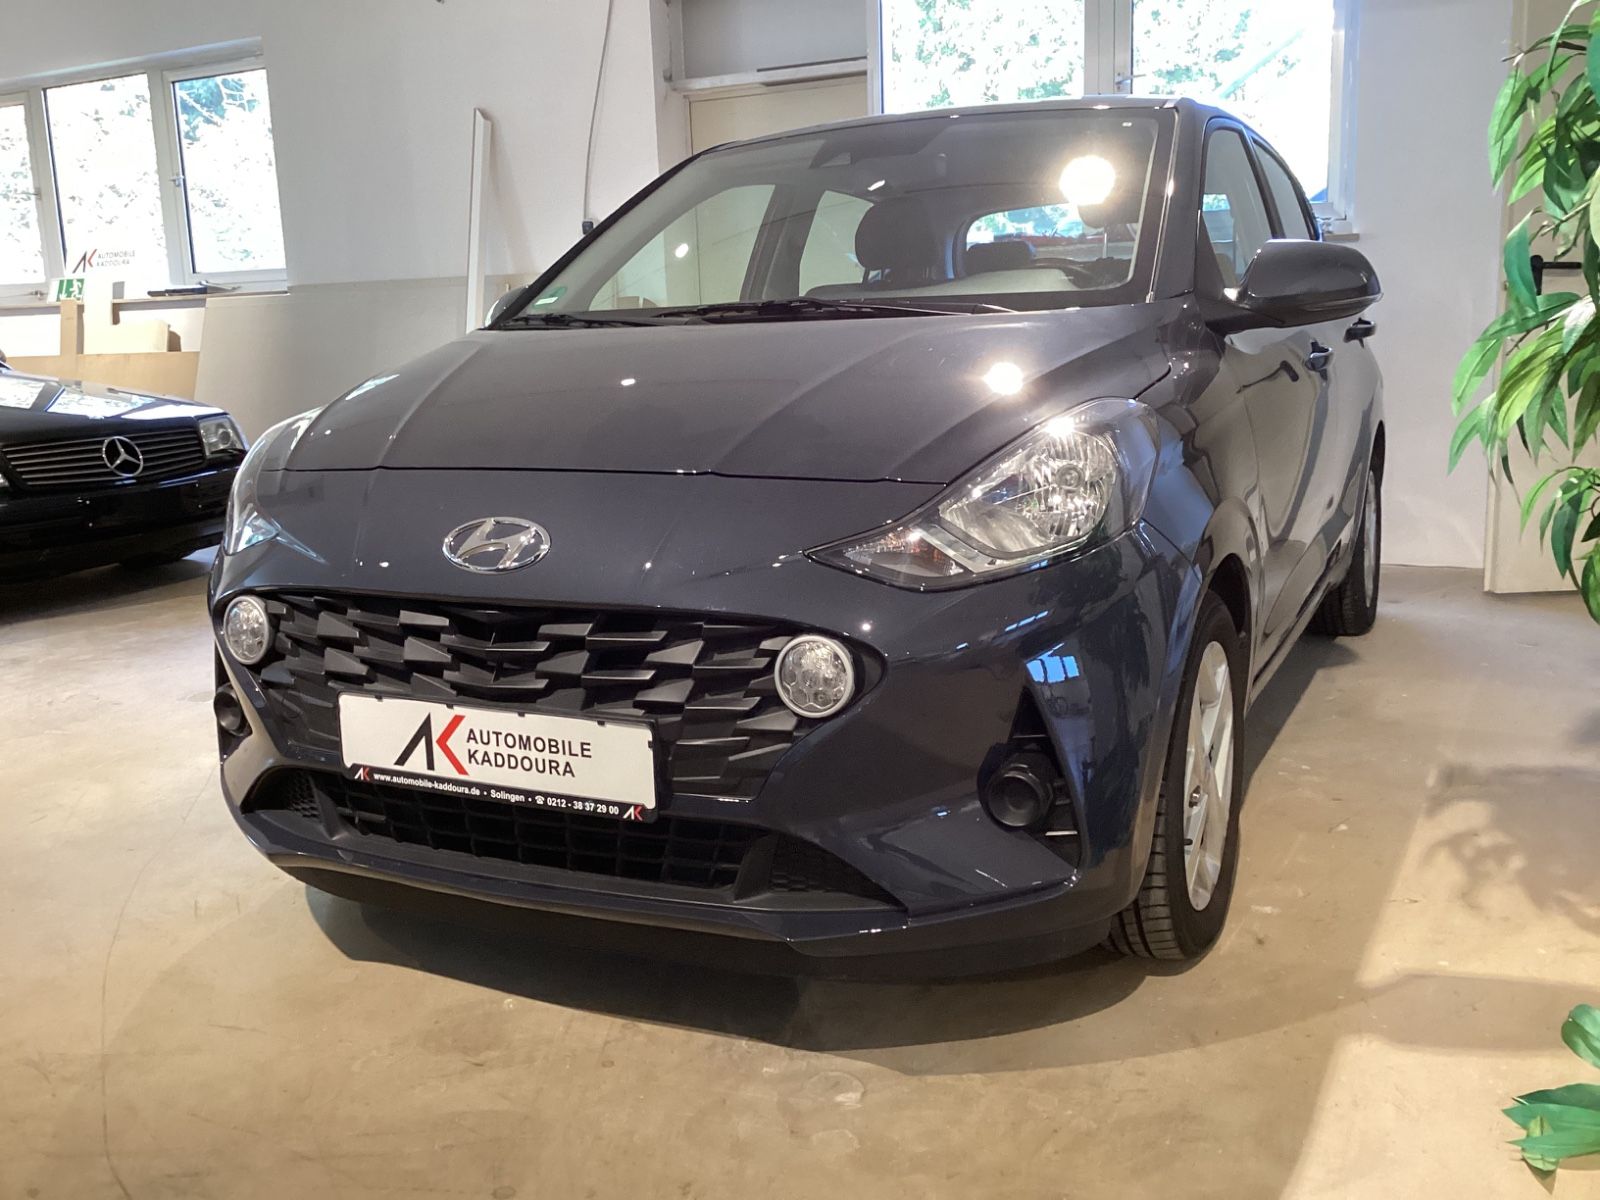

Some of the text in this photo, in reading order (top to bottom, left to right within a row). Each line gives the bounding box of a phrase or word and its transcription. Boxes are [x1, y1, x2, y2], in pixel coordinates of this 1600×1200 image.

[393, 712, 470, 777] AK
[466, 728, 592, 759] AUTOMOBILE
[467, 748, 576, 778] KADDOURA
[373, 773, 480, 796] www.automobile-kaddoura.de
[490, 789, 525, 803] Solingen
[547, 797, 567, 808] 0212
[573, 800, 583, 811] 38
[585, 801, 595, 812] 37
[597, 803, 607, 814] 29
[609, 805, 619, 815] 00
